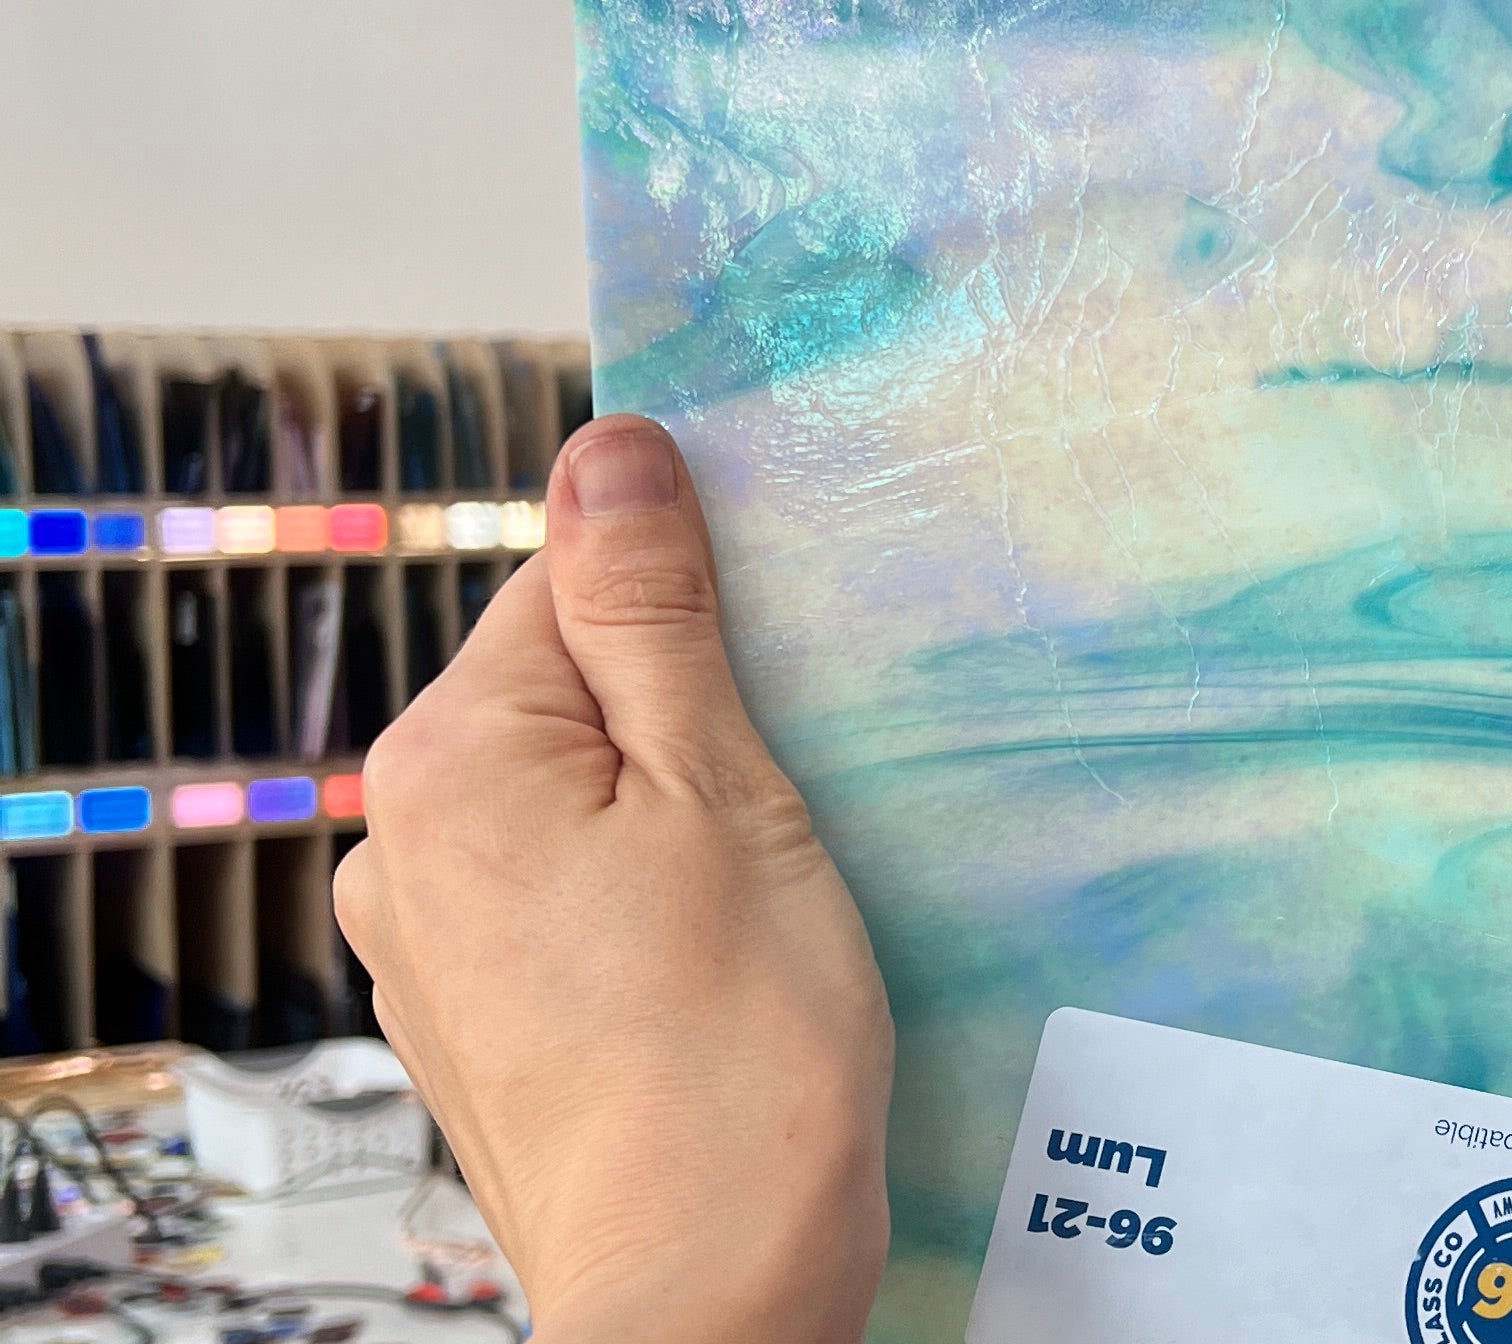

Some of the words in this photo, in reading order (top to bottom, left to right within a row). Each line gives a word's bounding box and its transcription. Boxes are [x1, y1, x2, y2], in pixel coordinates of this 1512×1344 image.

[1047, 1129, 1167, 1188] Lum
[1027, 1193, 1178, 1255] 96-21
[1434, 1232, 1463, 1267] CO
